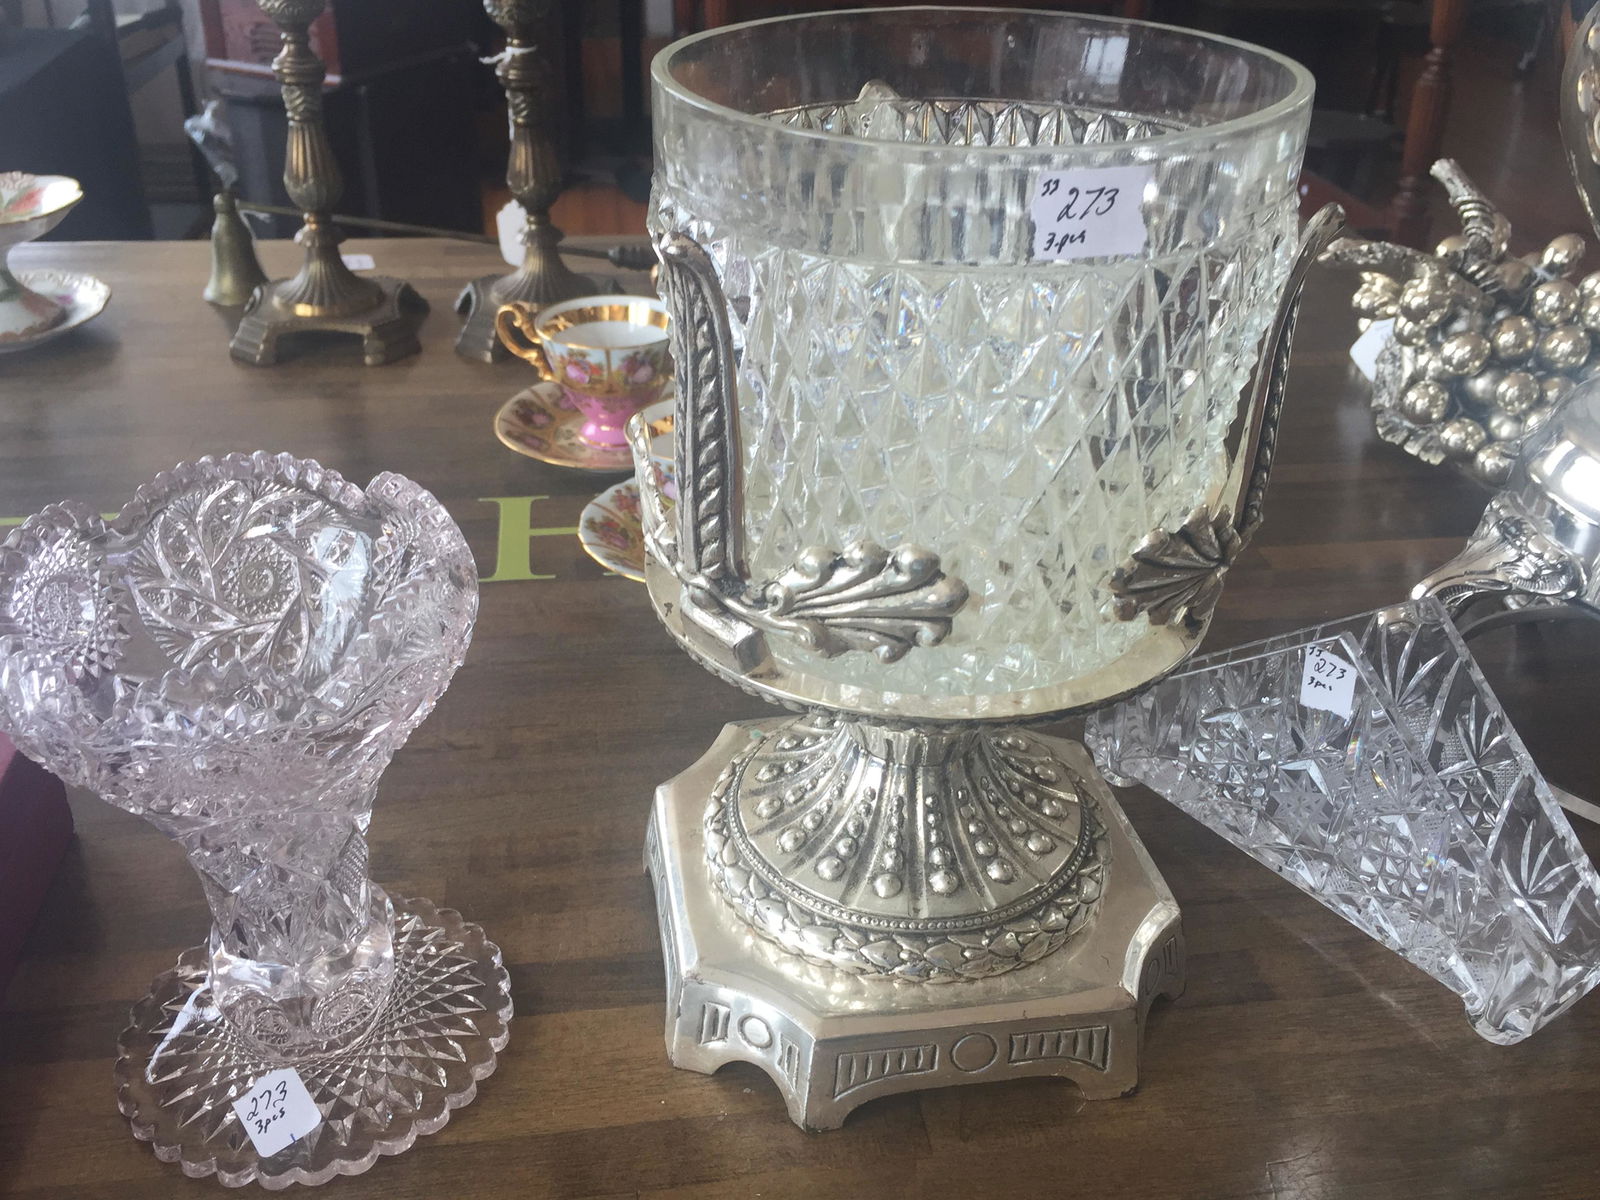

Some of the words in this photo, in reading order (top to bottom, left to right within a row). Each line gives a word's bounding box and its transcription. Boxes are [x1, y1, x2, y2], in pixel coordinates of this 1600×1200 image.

[1056, 186, 1120, 223] 273
[1313, 658, 1347, 680] 273
[246, 1080, 287, 1121] 273
